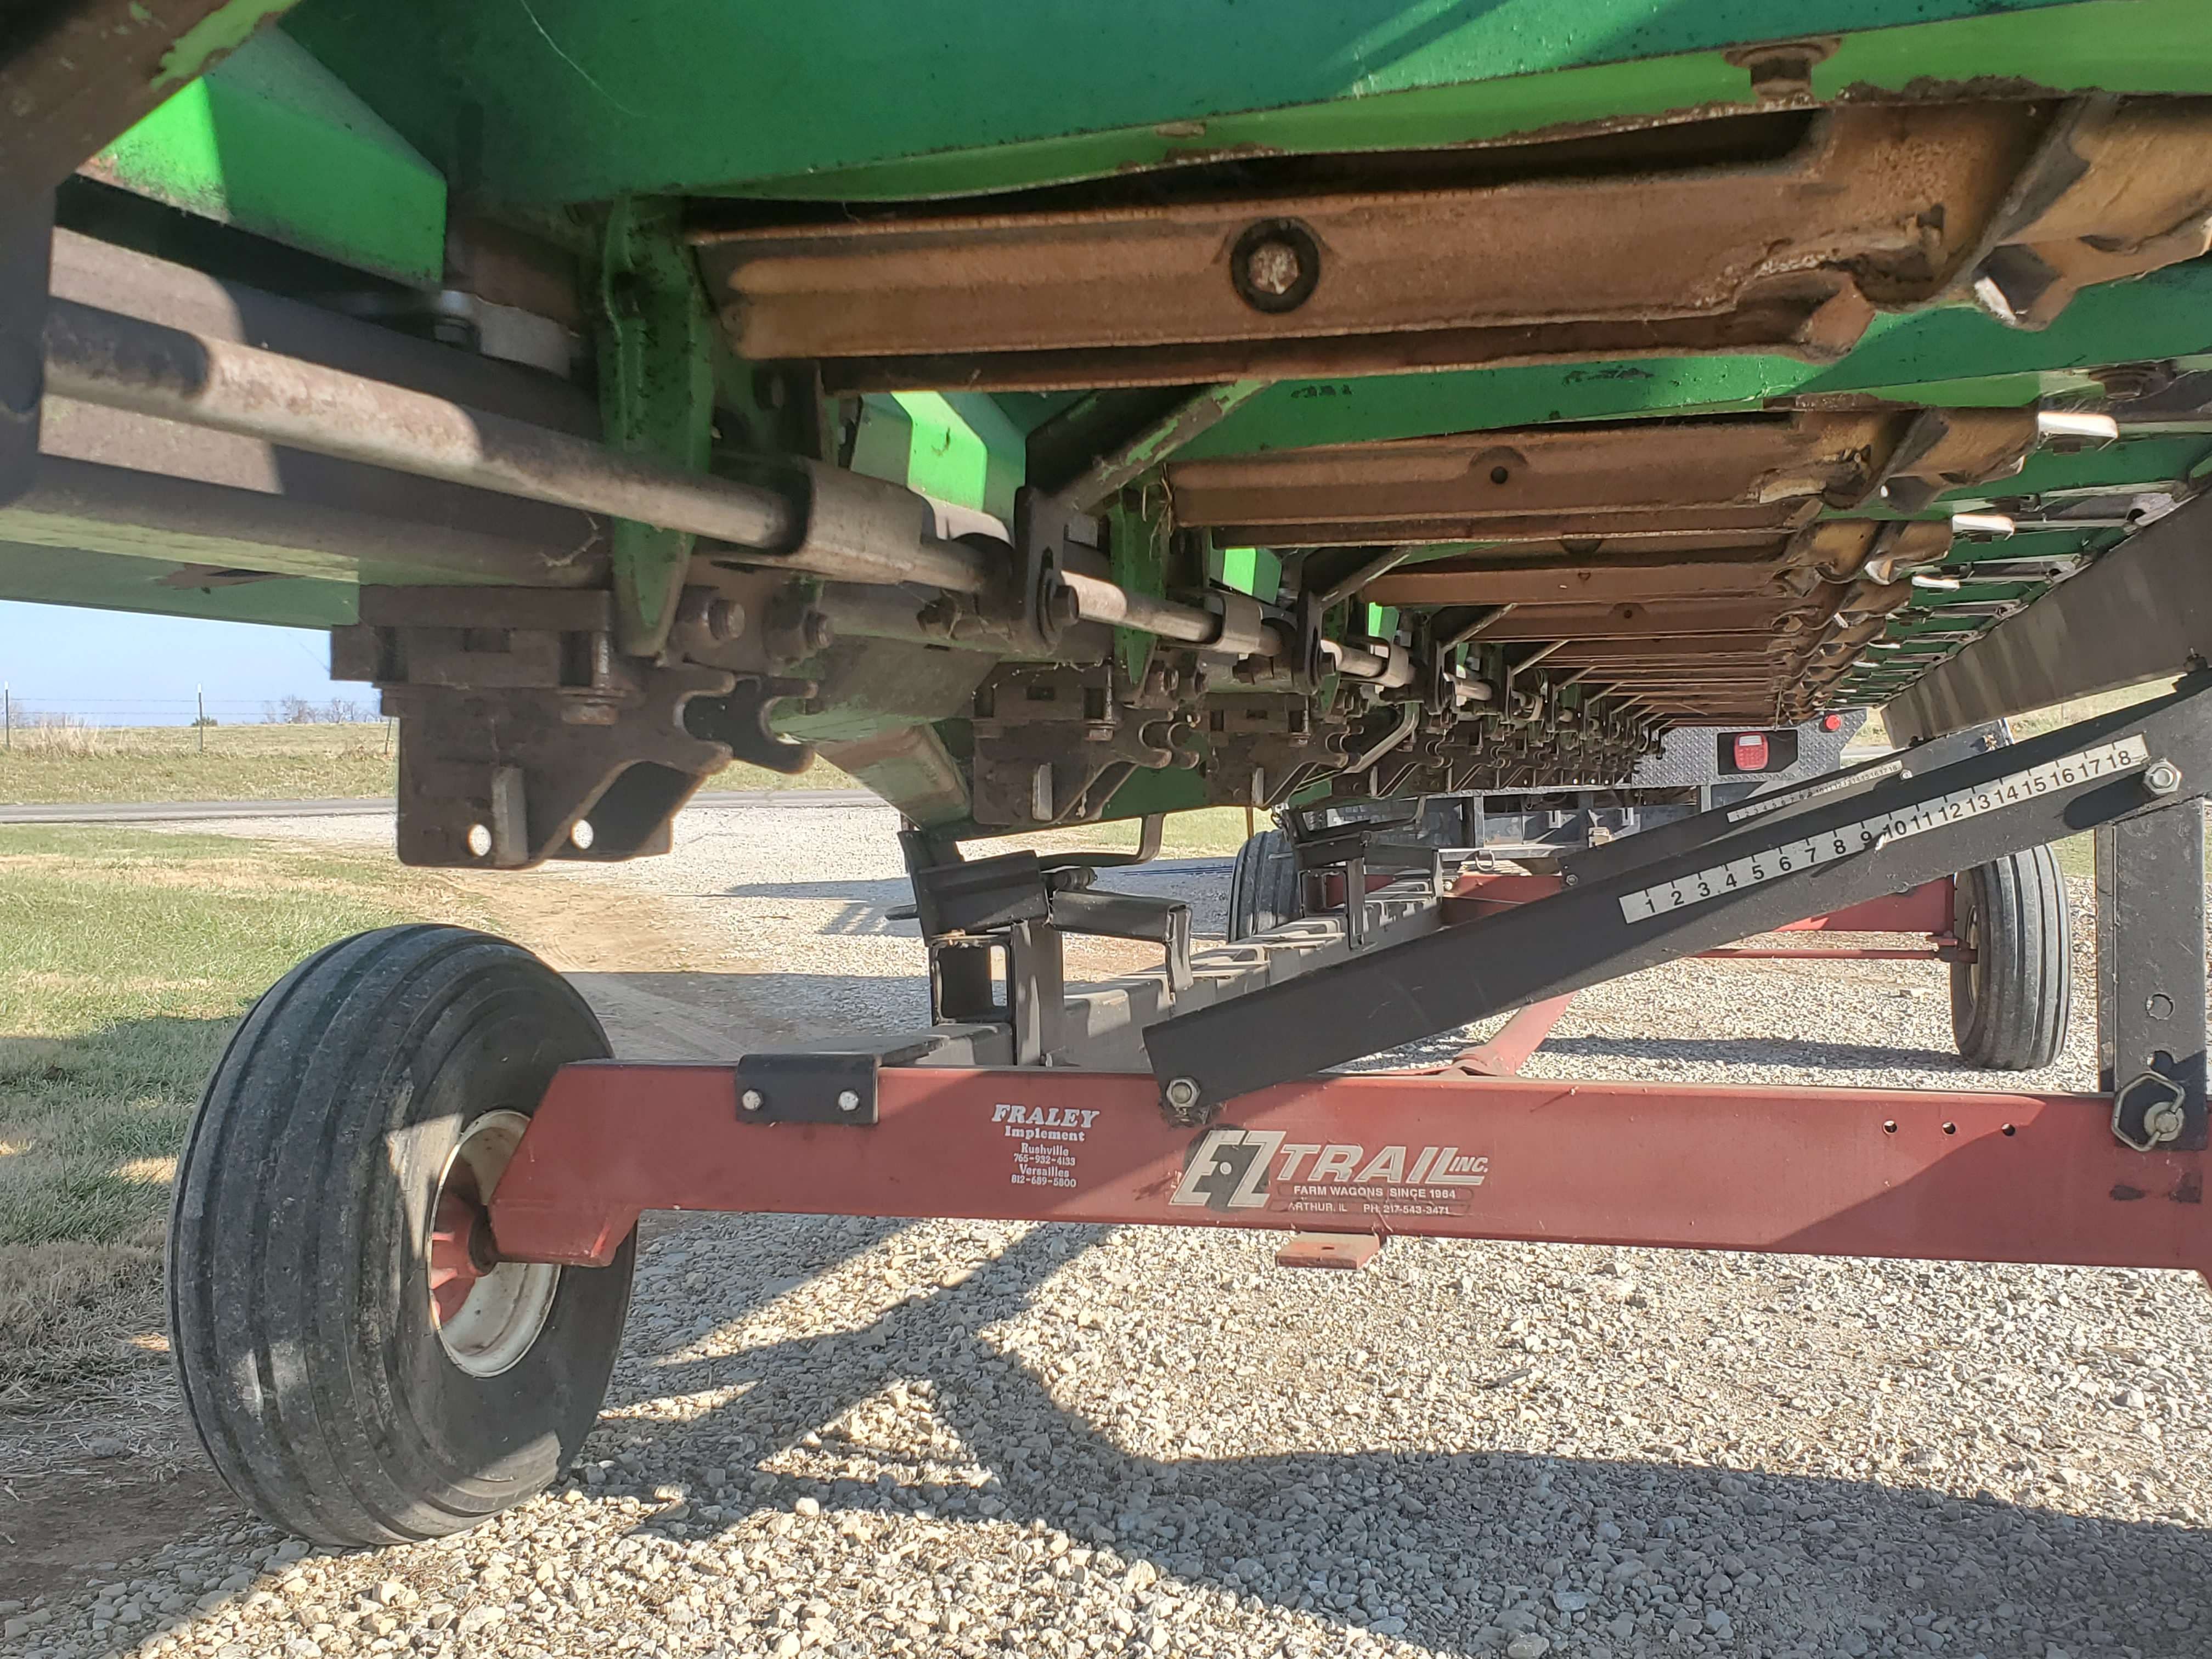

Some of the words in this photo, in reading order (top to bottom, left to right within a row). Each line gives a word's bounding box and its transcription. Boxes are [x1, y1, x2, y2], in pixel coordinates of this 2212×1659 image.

[1646, 899, 1655, 913] 1
[1671, 891, 1684, 906] 2
[1697, 882, 1711, 897] 3
[1725, 873, 1737, 887] 4
[1752, 865, 1765, 880] 5
[1779, 856, 1792, 871] 6
[1804, 847, 1816, 862] 7
[1833, 839, 1846, 854] 8
[1860, 831, 1872, 845] 9
[1882, 820, 1907, 838] 10
[1911, 811, 1933, 830] 11
[1938, 803, 1963, 821] 12
[1966, 794, 1991, 812] 13
[1994, 786, 2019, 804] 14
[2022, 776, 2046, 795] 15
[2050, 768, 2075, 786] 16
[2078, 759, 2100, 777] 17
[2107, 751, 2131, 769] 18
[991, 1104, 1100, 1128] FRALEY
[1005, 1125, 1085, 1142] Implement
[1021, 1142, 1069, 1156] Rushville
[1019, 1164, 1070, 1178] Versailles
[1277, 1144, 1485, 1186] TRAIL
[1448, 1156, 1488, 1173] INC.
[1294, 1185, 1327, 1196] FARM
[1330, 1186, 1383, 1198] WAGONS
[1390, 1188, 1426, 1198] SINCE
[1430, 1189, 1455, 1199] 1964
[1339, 1202, 1348, 1212] IL
